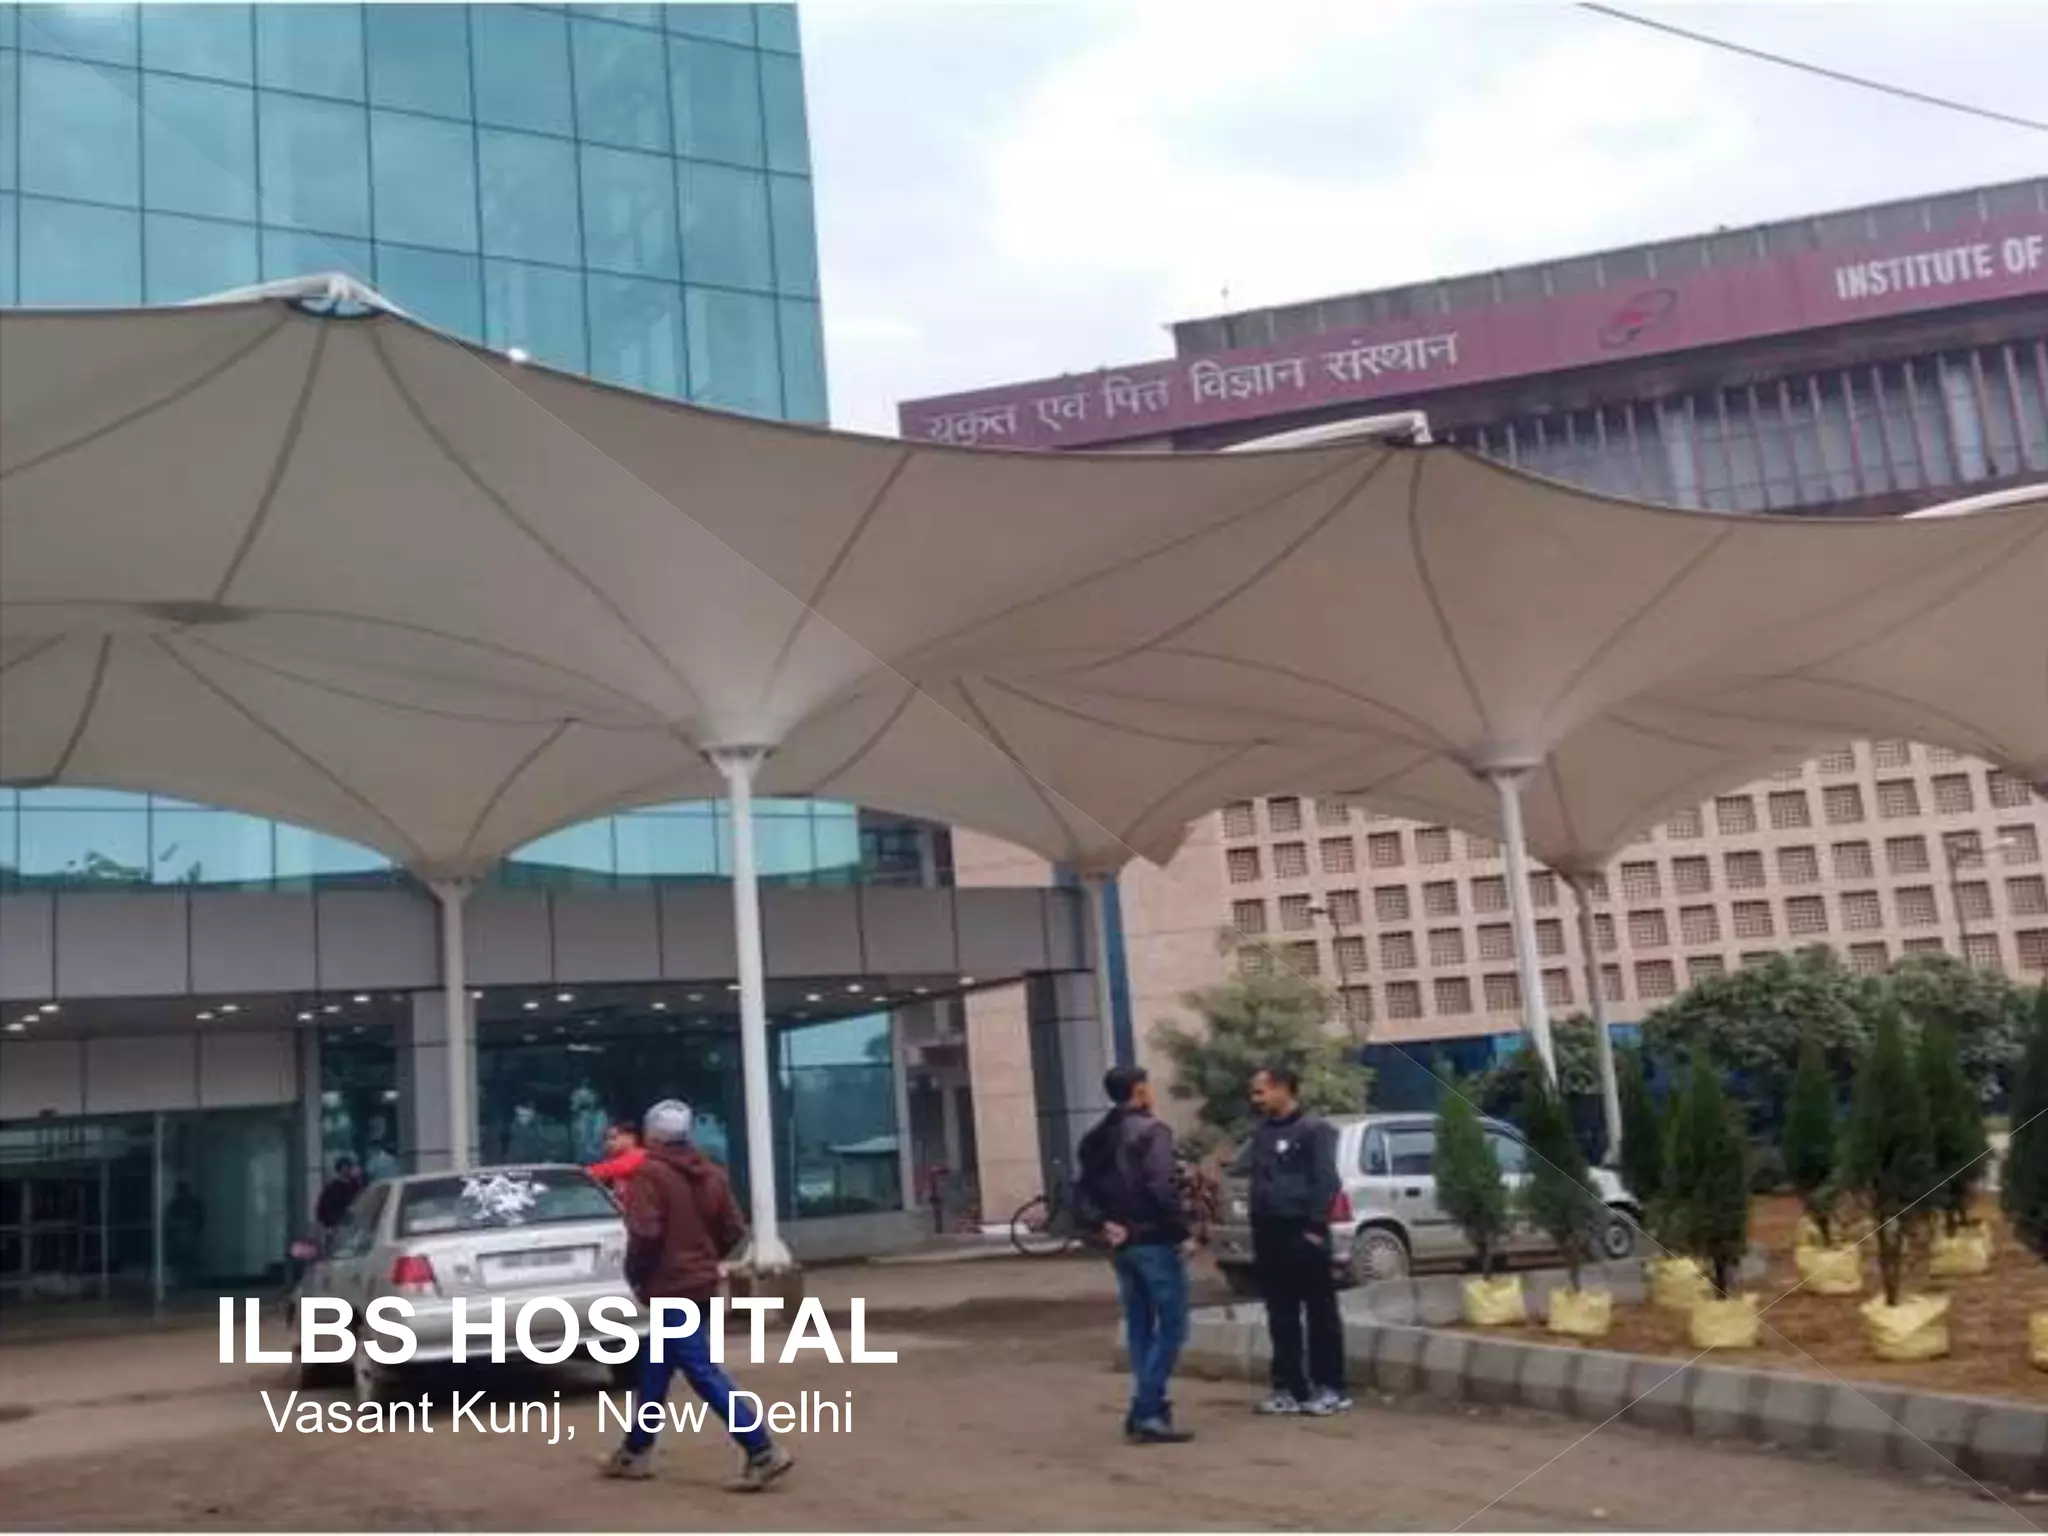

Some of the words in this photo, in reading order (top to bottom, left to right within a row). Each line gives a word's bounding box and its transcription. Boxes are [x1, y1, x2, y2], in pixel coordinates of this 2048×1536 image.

[1836, 244, 1994, 299] INSTITUTE
[2002, 235, 2044, 273] OF
[1189, 357, 1308, 403] विज्ञान
[1322, 331, 1458, 382] संस्थान
